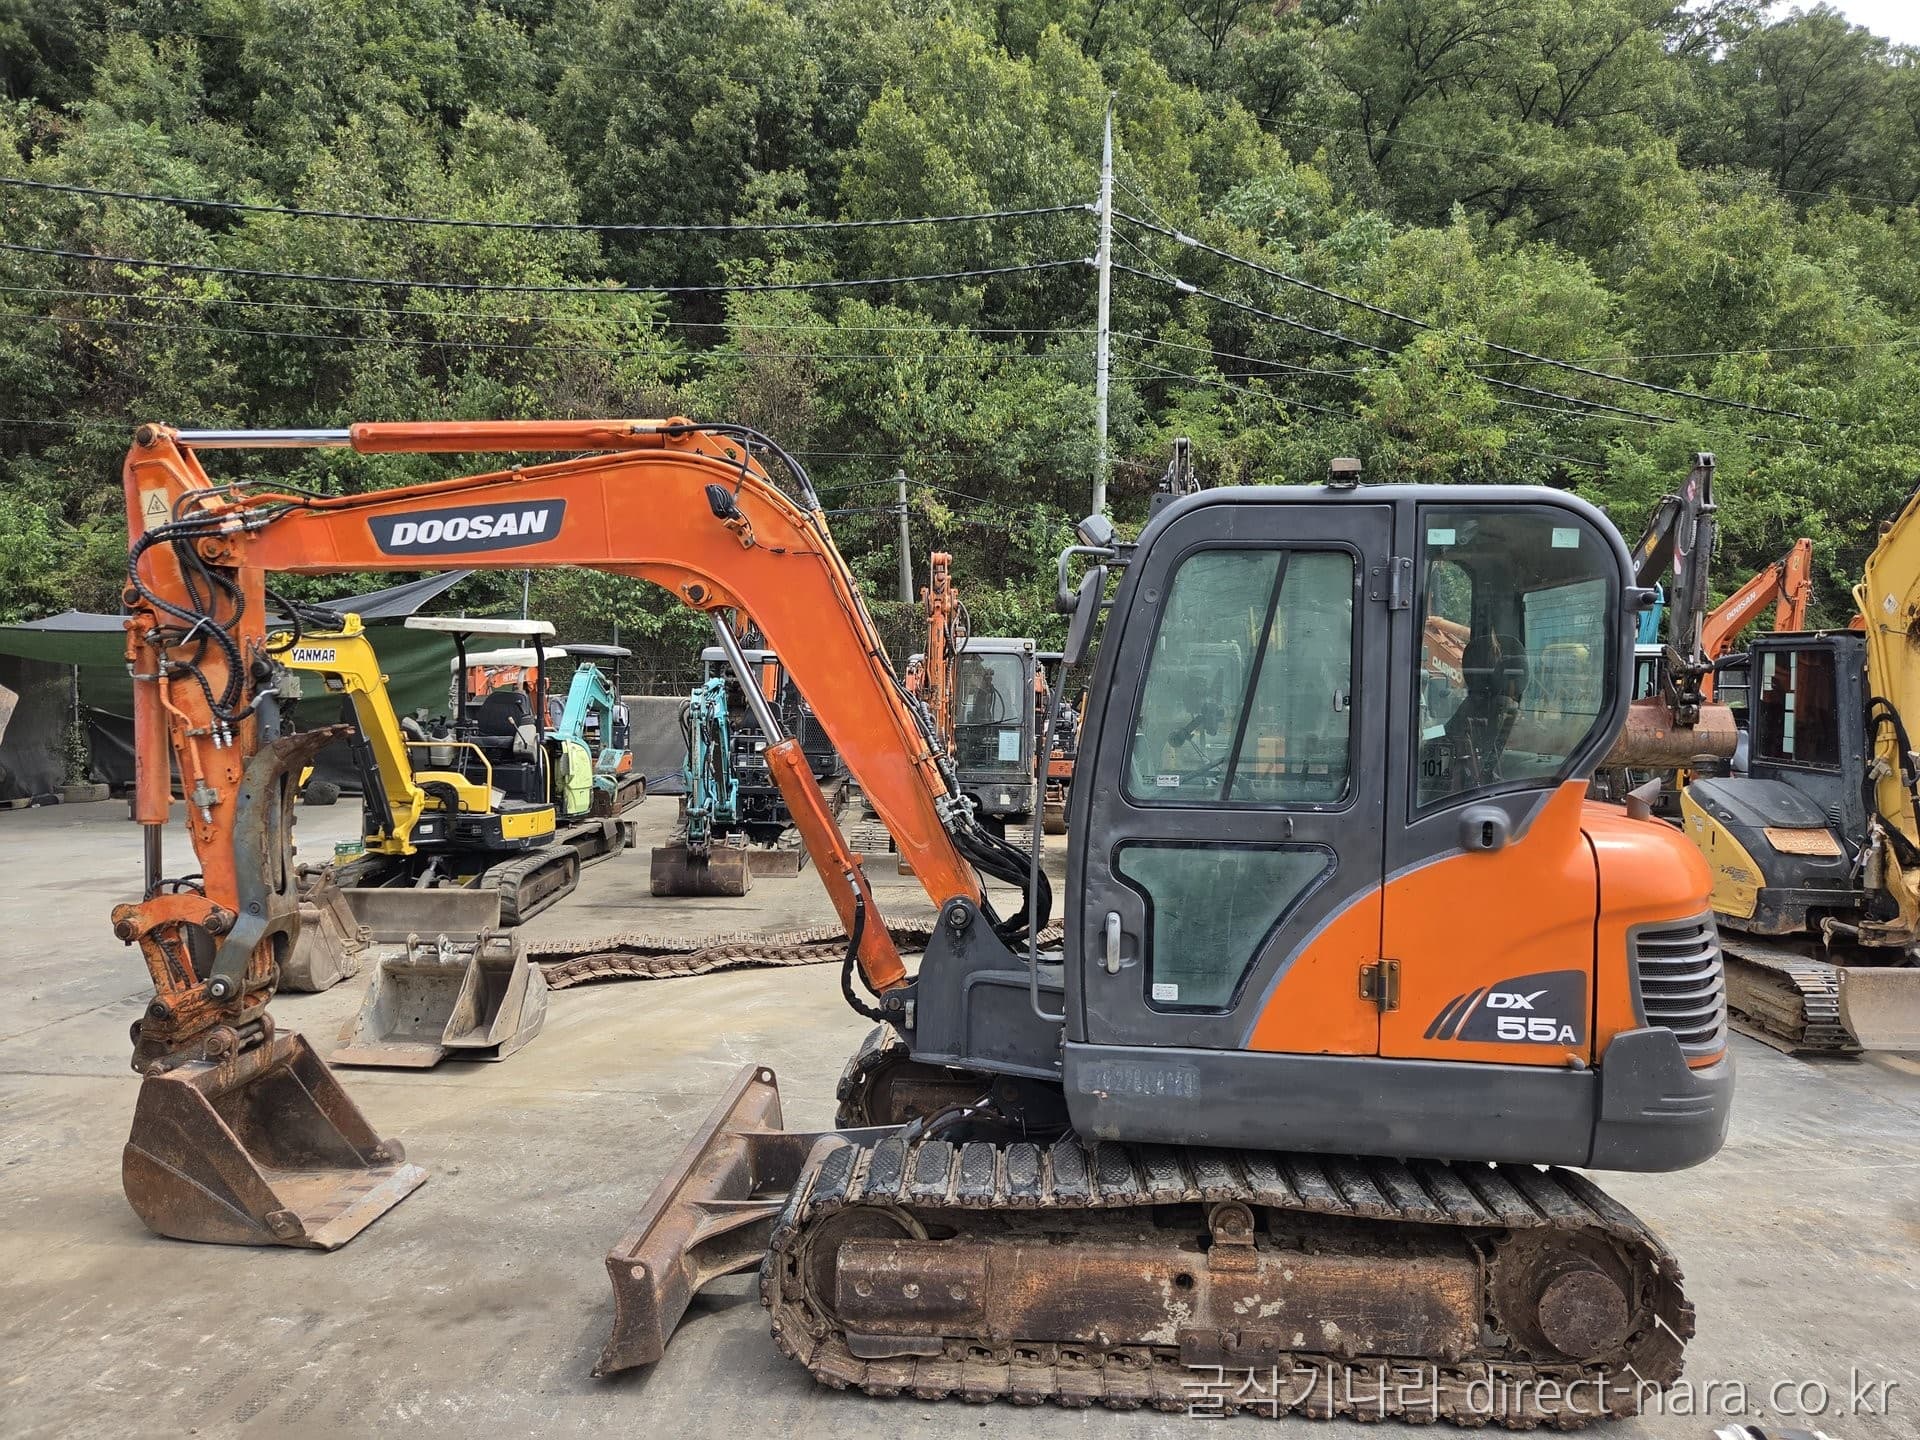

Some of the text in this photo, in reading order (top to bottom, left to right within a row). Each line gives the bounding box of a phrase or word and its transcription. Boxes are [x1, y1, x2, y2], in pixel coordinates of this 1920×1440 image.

[390, 509, 549, 547] DOOSAN
[291, 648, 336, 663] YANMAR
[1486, 990, 1549, 1010] DX
[1496, 1015, 1577, 1043] 55A
